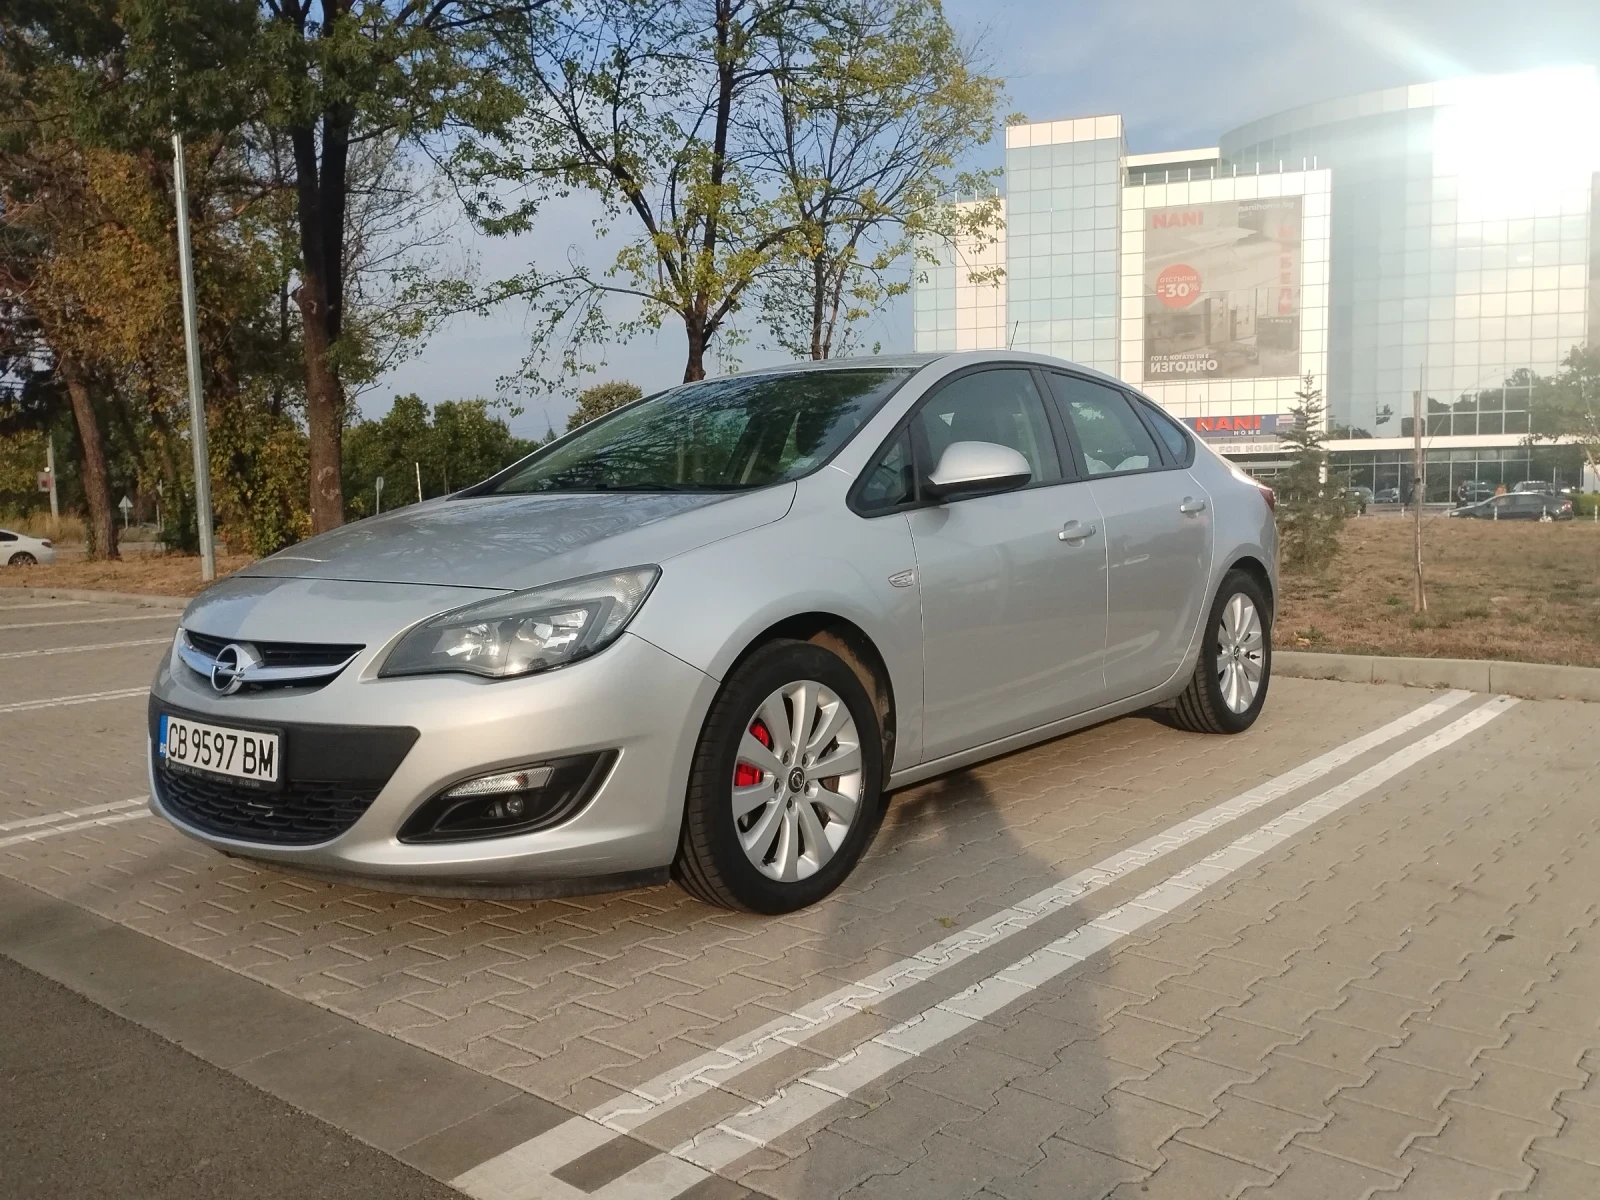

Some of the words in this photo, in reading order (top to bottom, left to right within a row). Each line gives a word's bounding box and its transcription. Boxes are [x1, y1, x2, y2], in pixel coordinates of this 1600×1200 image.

[1153, 211, 1204, 229] NANI
[1159, 275, 1197, 283] ОТСТЪПКИ
[1158, 282, 1199, 298] -30%
[1150, 359, 1218, 373] ИЗГОДНО
[1195, 415, 1261, 432] NANI
[1218, 445, 1241, 453] FOR
[1245, 444, 1281, 453] HOME
[169, 723, 187, 760] CB
[192, 728, 238, 770] 9597
[242, 737, 274, 778] BM
